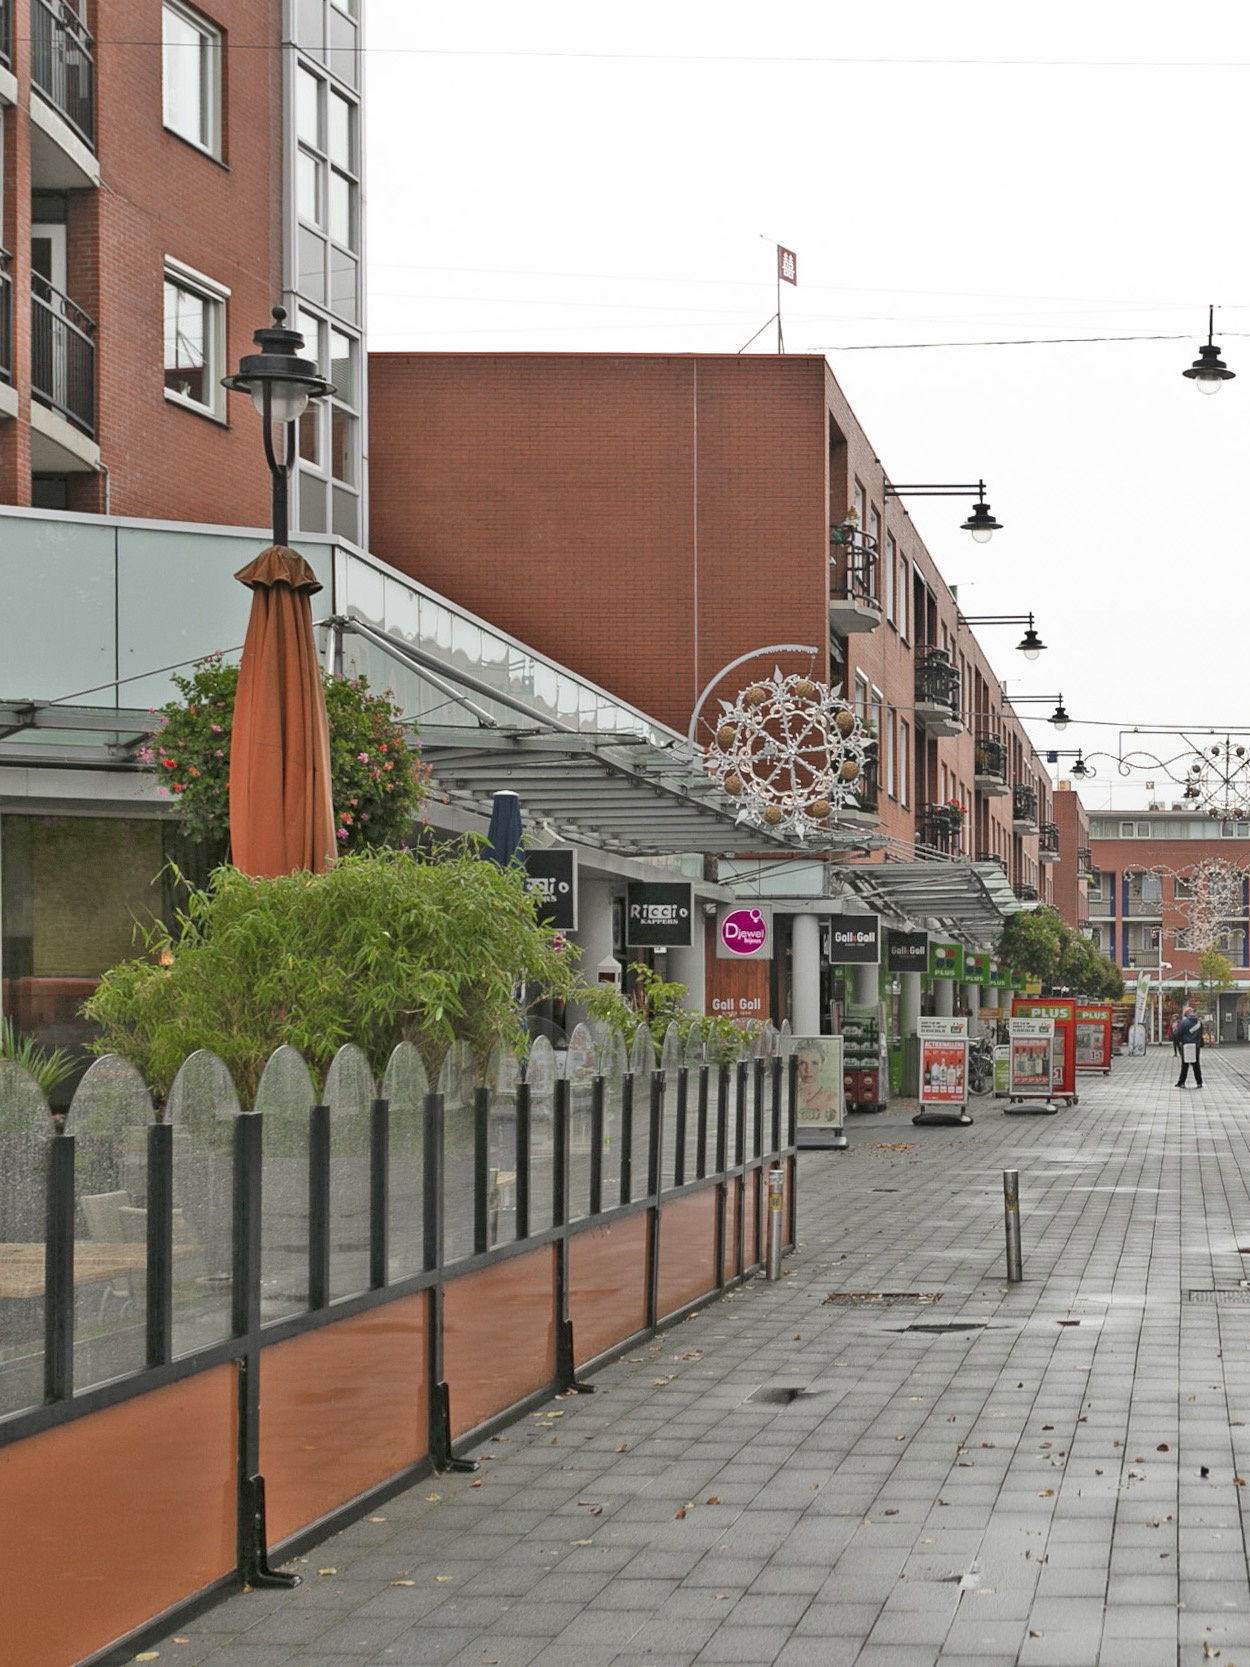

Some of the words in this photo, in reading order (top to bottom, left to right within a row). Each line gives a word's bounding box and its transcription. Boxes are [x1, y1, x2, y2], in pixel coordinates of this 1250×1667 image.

[630, 904, 689, 919] Riccio
[725, 922, 765, 940] Djewel
[856, 932, 875, 942] Gall
[712, 998, 735, 1010] Gall
[739, 998, 761, 1010] Gall
[1031, 1008, 1068, 1018] PLUS
[1082, 1011, 1107, 1019] PLUS
